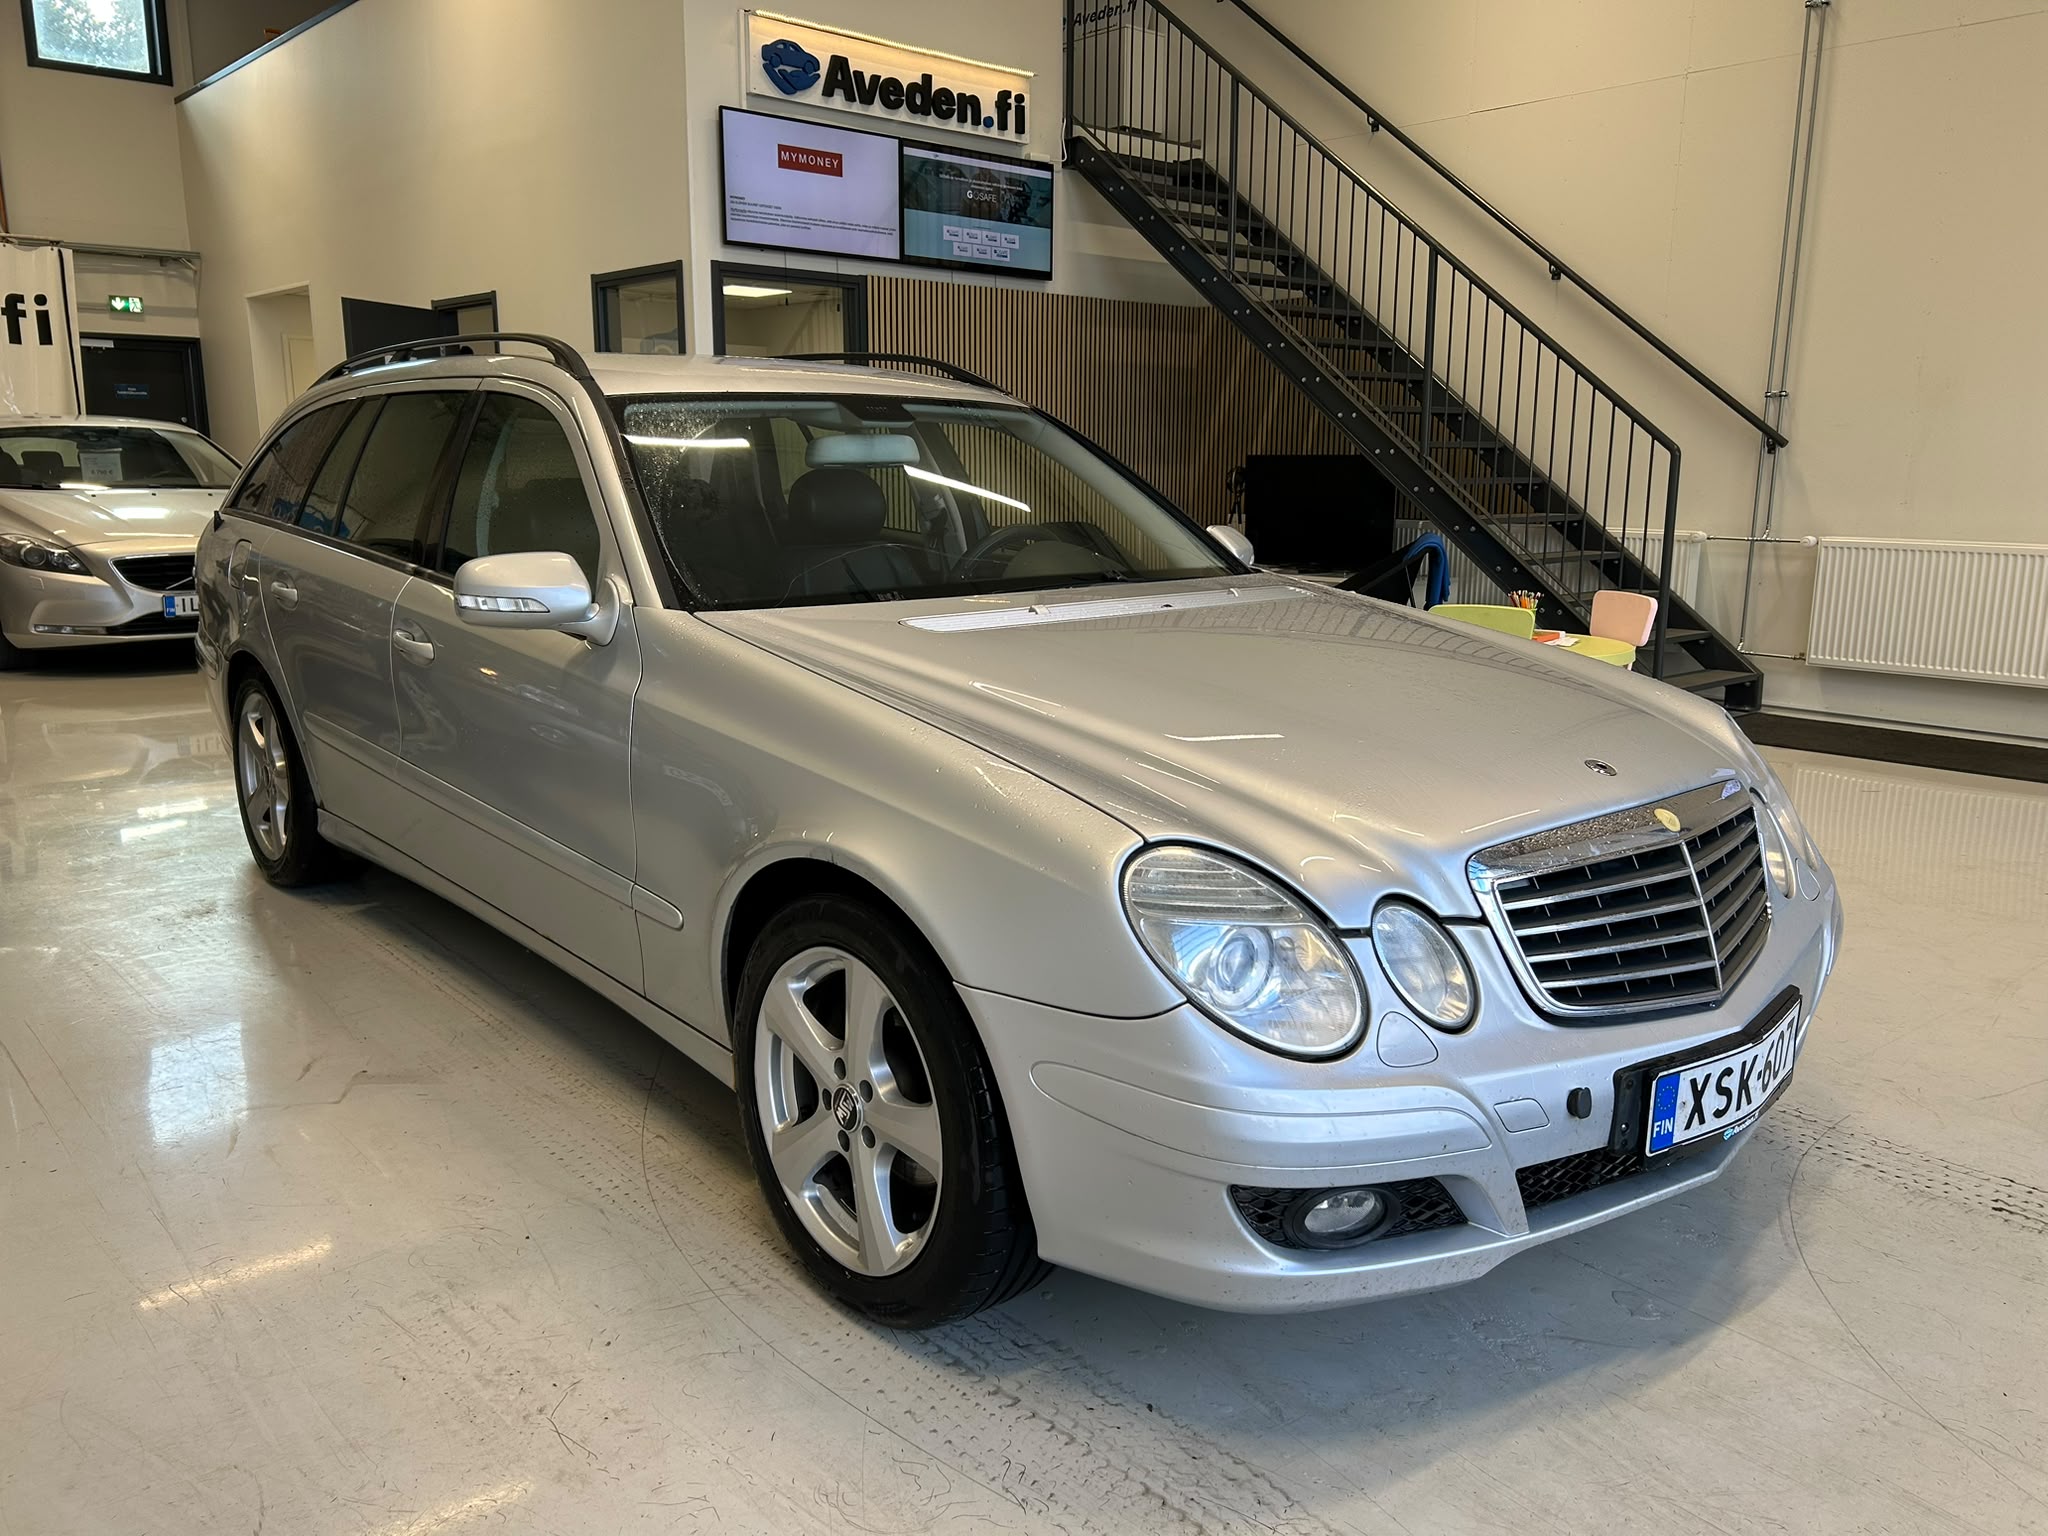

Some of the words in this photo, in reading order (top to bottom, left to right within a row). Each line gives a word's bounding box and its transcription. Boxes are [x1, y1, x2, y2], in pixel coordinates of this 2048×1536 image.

[821, 54, 1026, 135] Aveden.fi
[780, 150, 839, 169] MYMONEY
[1683, 1015, 1796, 1132] XSK-607
[1652, 1116, 1674, 1138] FIN
